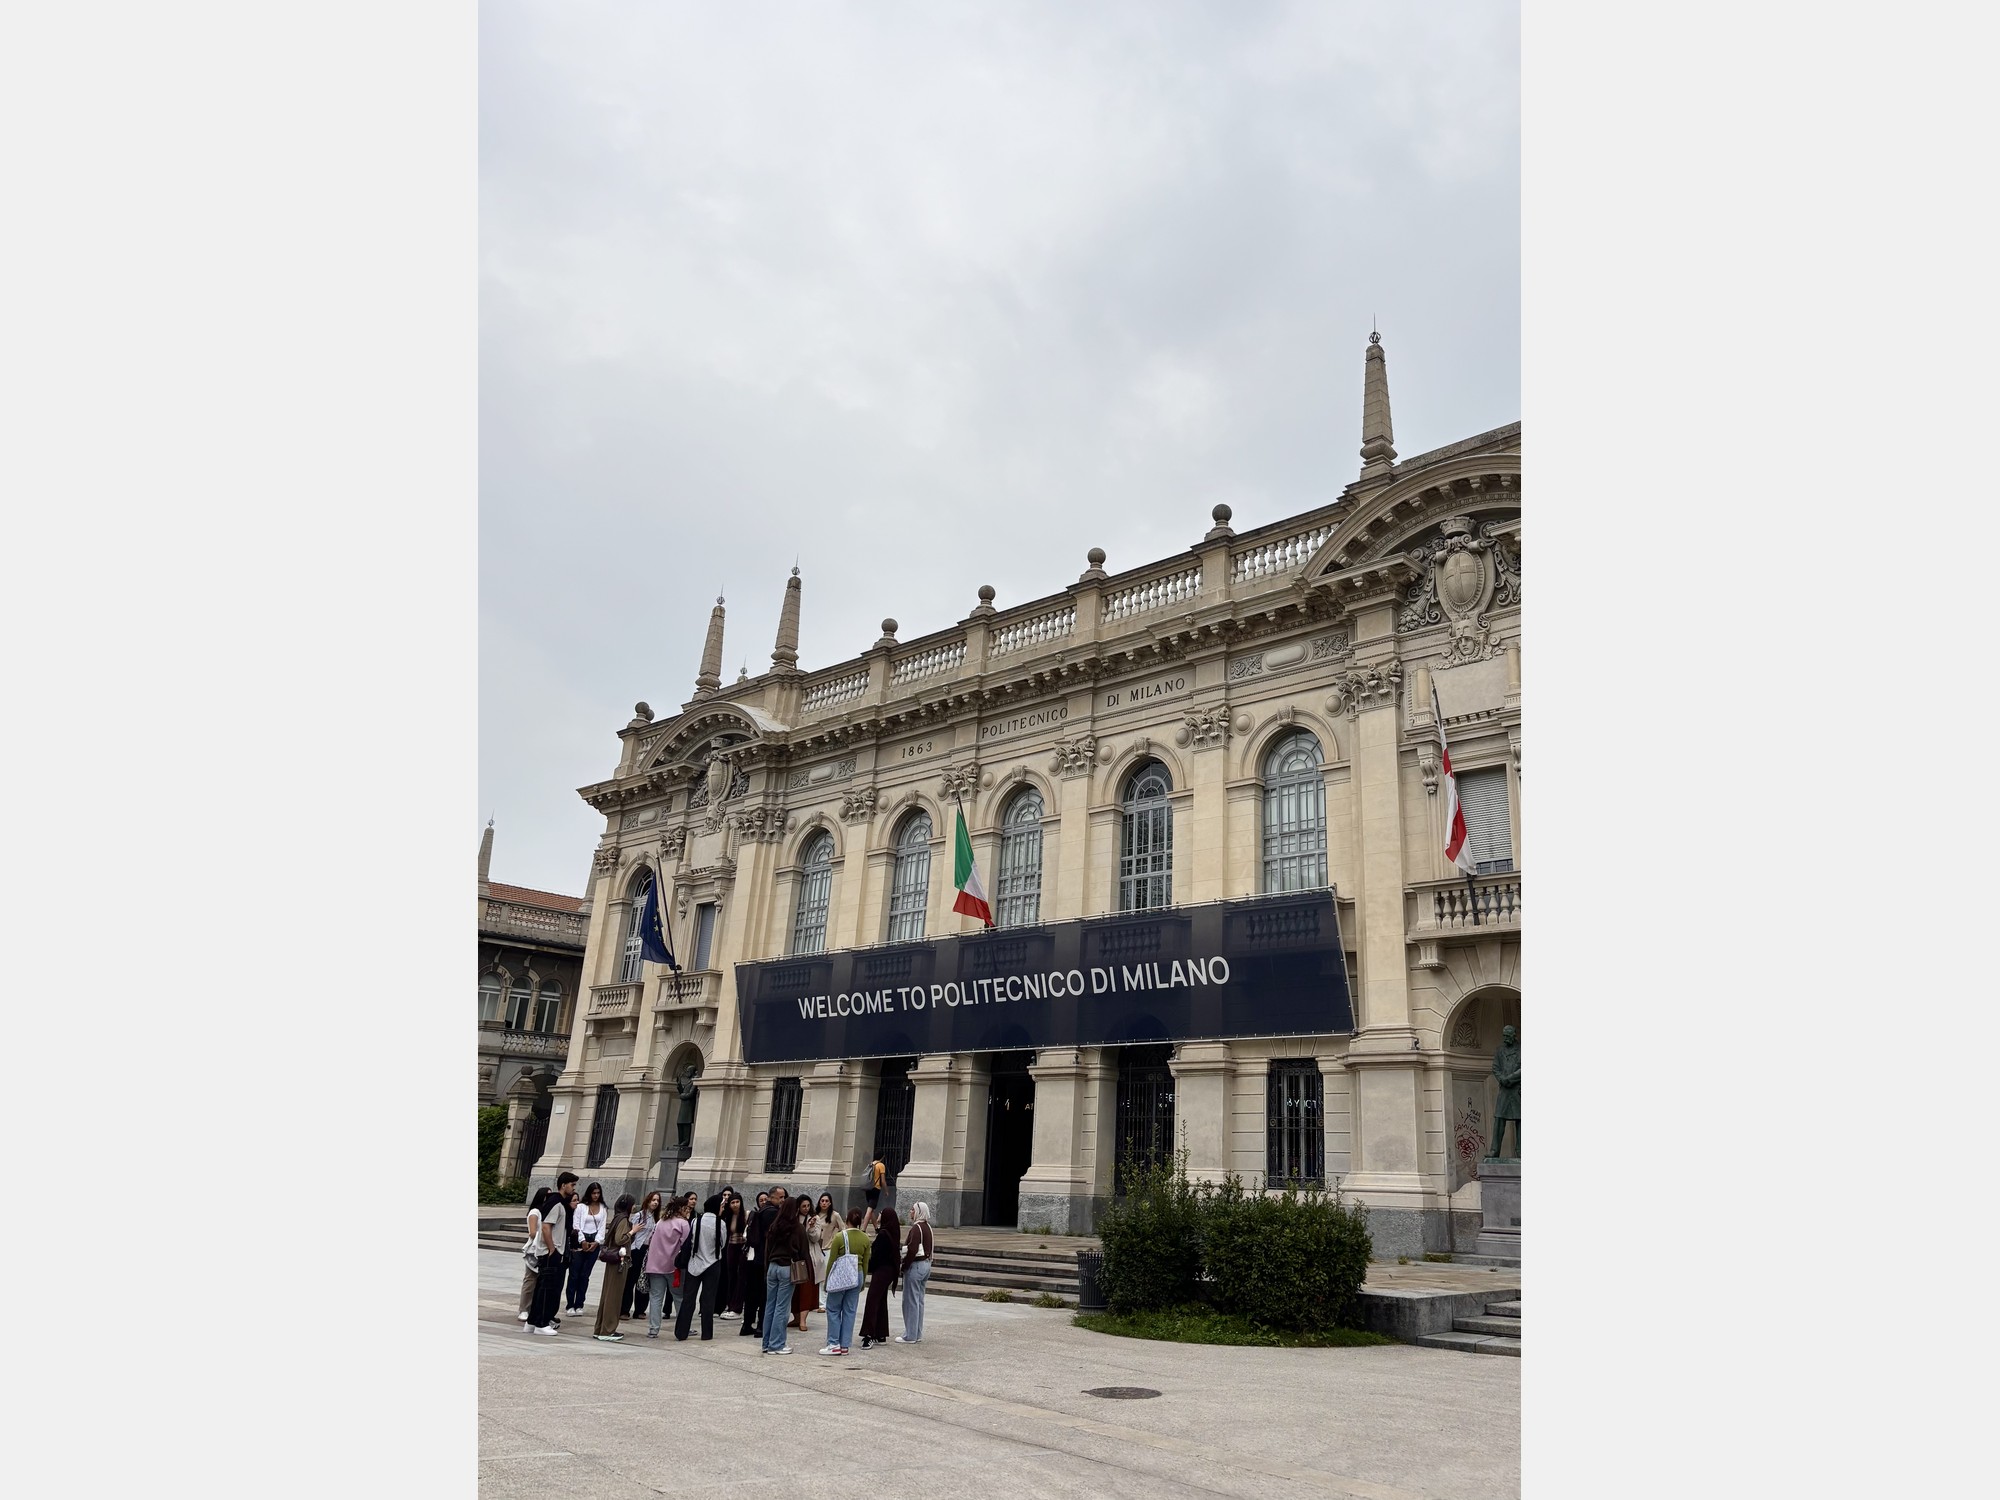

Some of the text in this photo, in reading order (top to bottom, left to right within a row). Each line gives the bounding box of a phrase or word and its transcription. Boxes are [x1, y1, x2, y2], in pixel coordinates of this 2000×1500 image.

[902, 677, 1185, 759] 1863 POLITECNICO DI MILANO
[798, 956, 1230, 1020] WELCOME TO POLITECNICO DI MILANO
